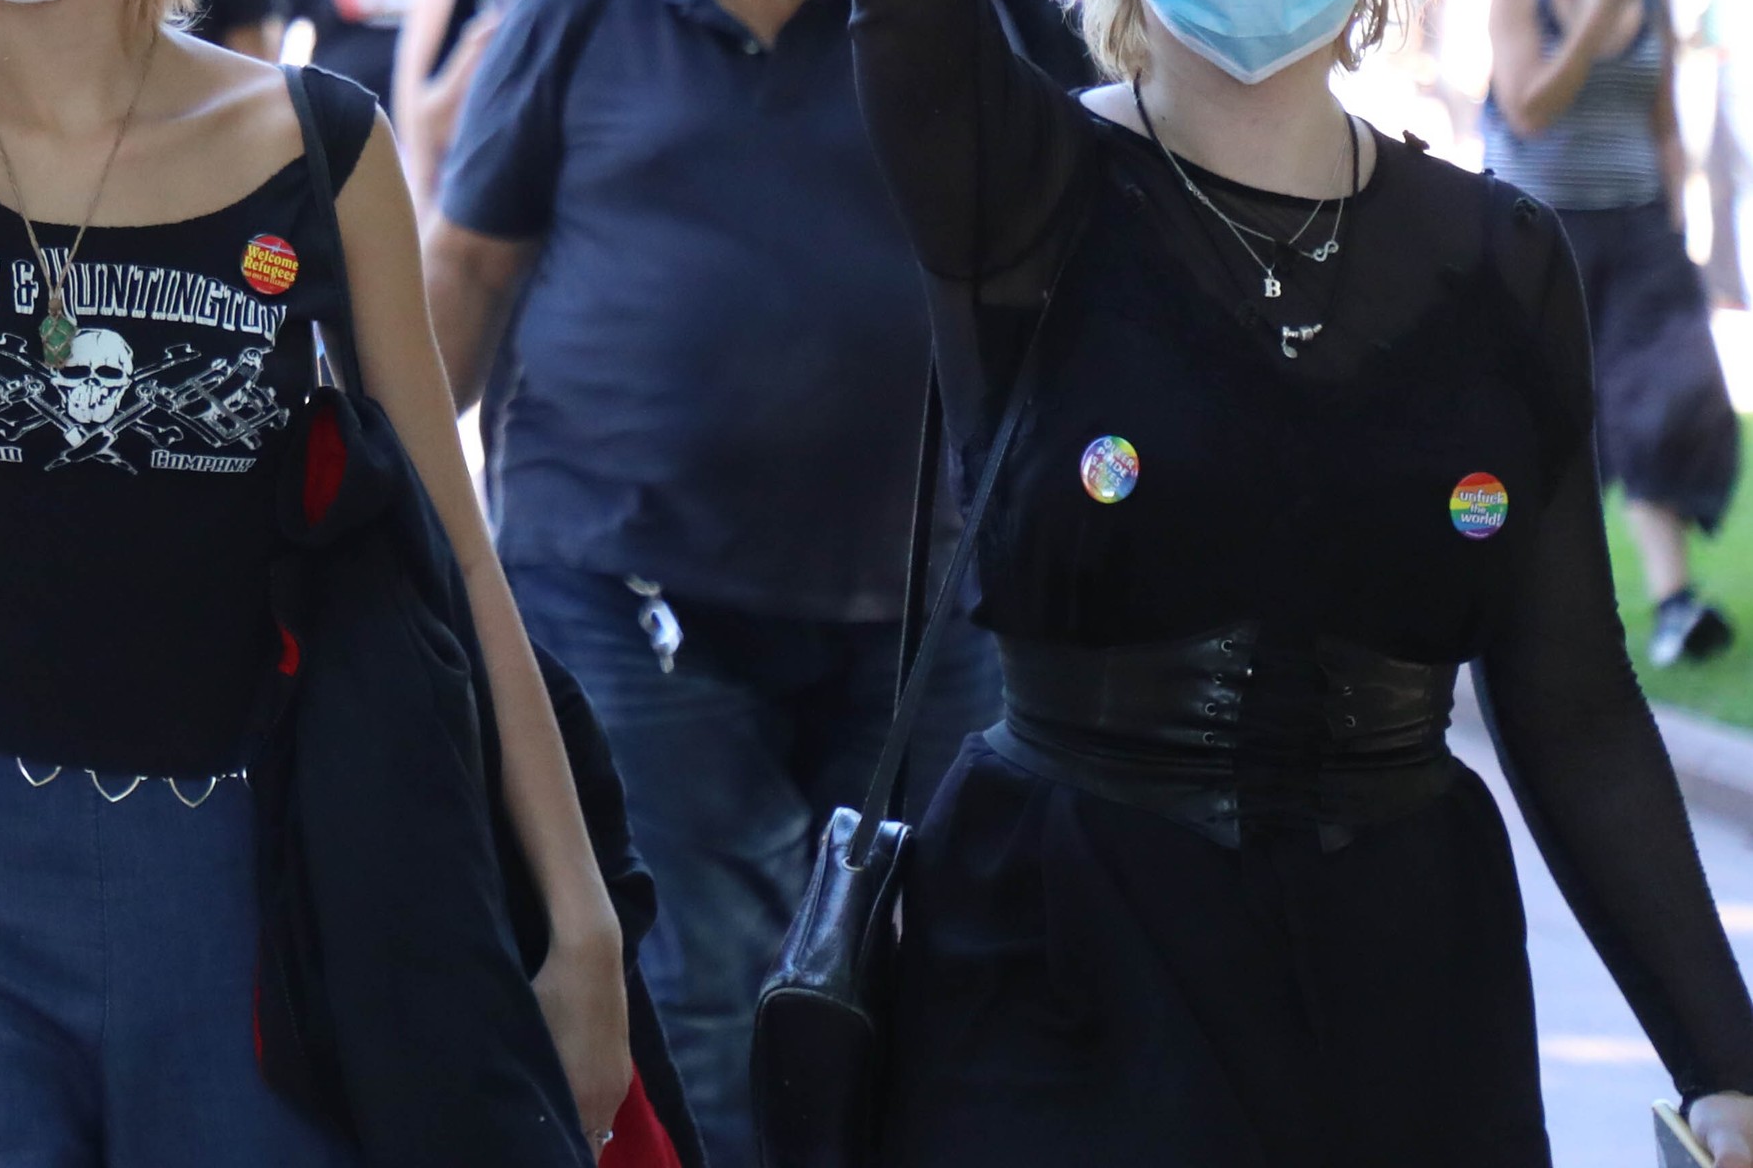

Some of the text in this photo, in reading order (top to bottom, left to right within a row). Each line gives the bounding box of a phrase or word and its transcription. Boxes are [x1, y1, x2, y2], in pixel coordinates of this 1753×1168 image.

[243, 255, 296, 282] Refugees
[247, 244, 299, 271] Welcome
[11, 258, 41, 316] &
[40, 246, 288, 341] HUNTINGTON
[1264, 277, 1282, 298] B
[150, 449, 257, 473] COMPANY
[1459, 489, 1504, 505] unfuck
[1460, 511, 1502, 528] world!
[1470, 503, 1487, 514] the
